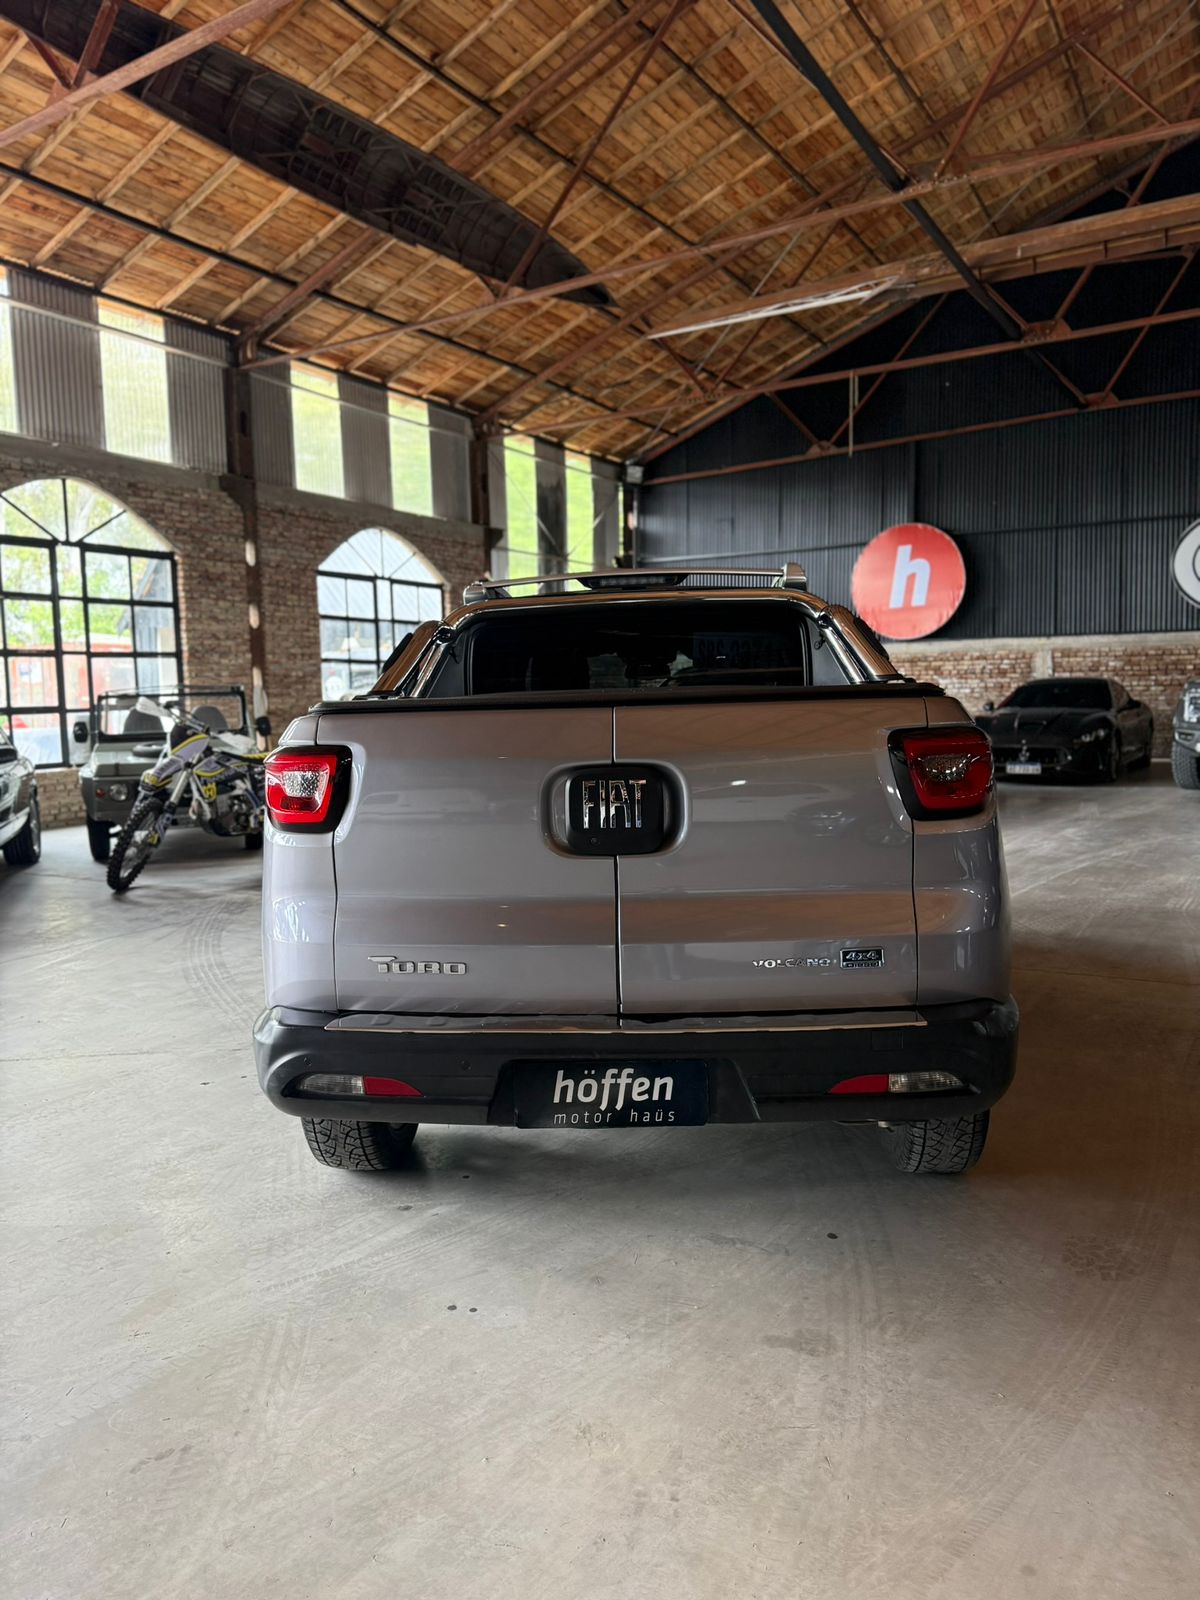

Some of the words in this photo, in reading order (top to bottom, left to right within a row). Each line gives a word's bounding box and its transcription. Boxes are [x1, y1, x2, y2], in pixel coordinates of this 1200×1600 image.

[888, 545, 932, 609] h
[582, 779, 647, 829] FIAT
[368, 955, 467, 975] TORO
[752, 958, 831, 969] VOLCANO
[553, 1068, 674, 1112] höffen
[553, 1111, 612, 1125] motor
[629, 1108, 675, 1123] haüs
